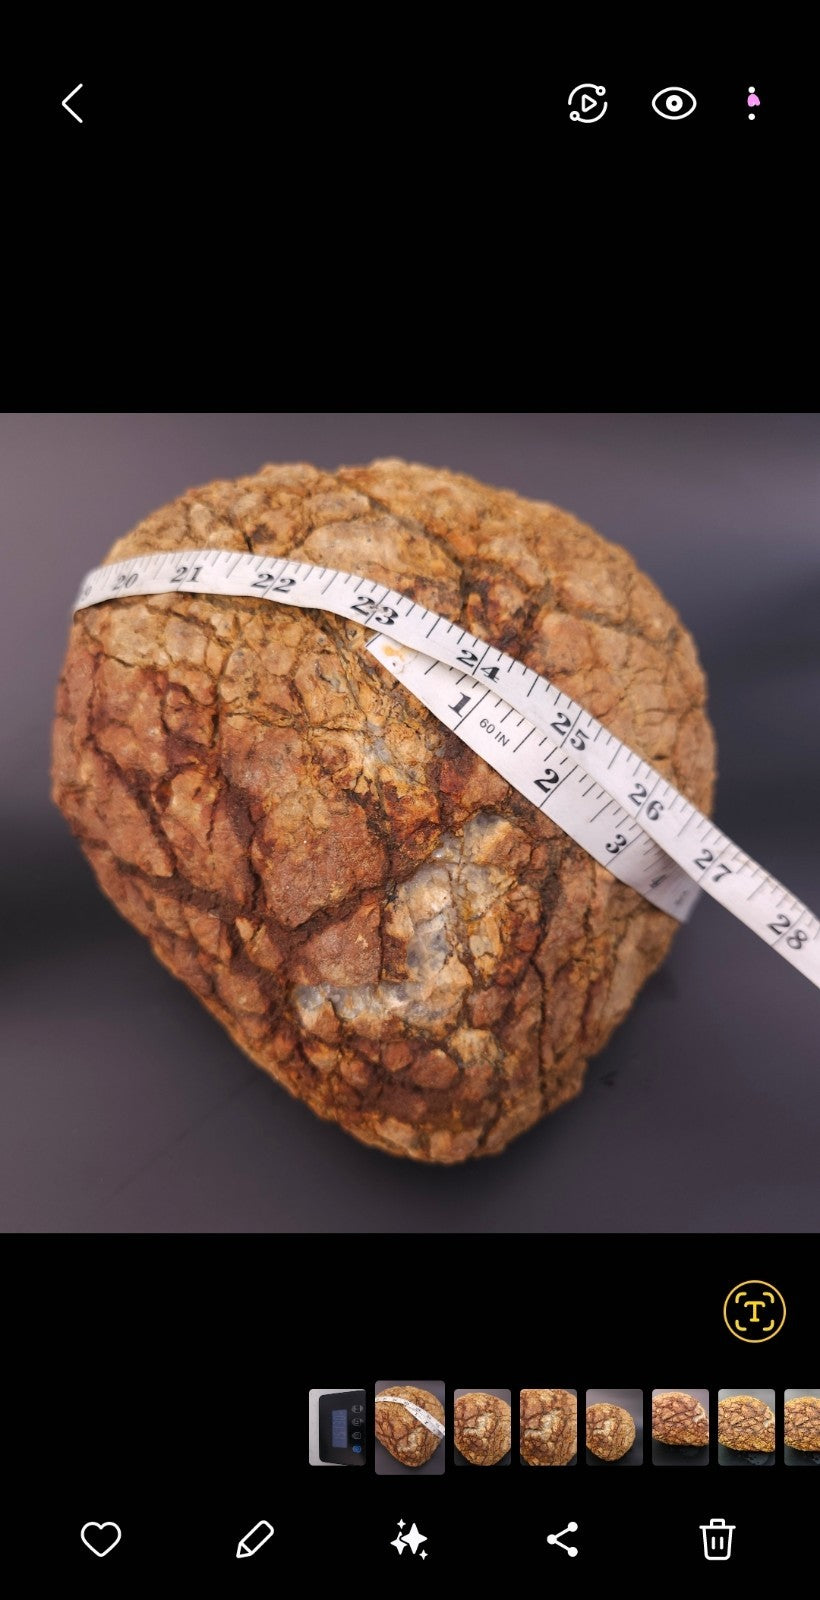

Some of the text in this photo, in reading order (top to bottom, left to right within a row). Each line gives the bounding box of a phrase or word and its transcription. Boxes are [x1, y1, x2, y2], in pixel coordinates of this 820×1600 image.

[112, 573, 139, 591] 20
[170, 566, 203, 584] 21
[251, 573, 297, 593] 22
[350, 596, 399, 626] 23
[456, 649, 501, 684] 24
[550, 712, 591, 752] 25
[628, 783, 664, 821] 26
[694, 848, 733, 883] 27
[767, 913, 808, 951] 28
[448, 692, 472, 718] 1
[533, 768, 560, 794] 2
[605, 834, 627, 854] 3
[480, 718, 510, 747] 60 IN
